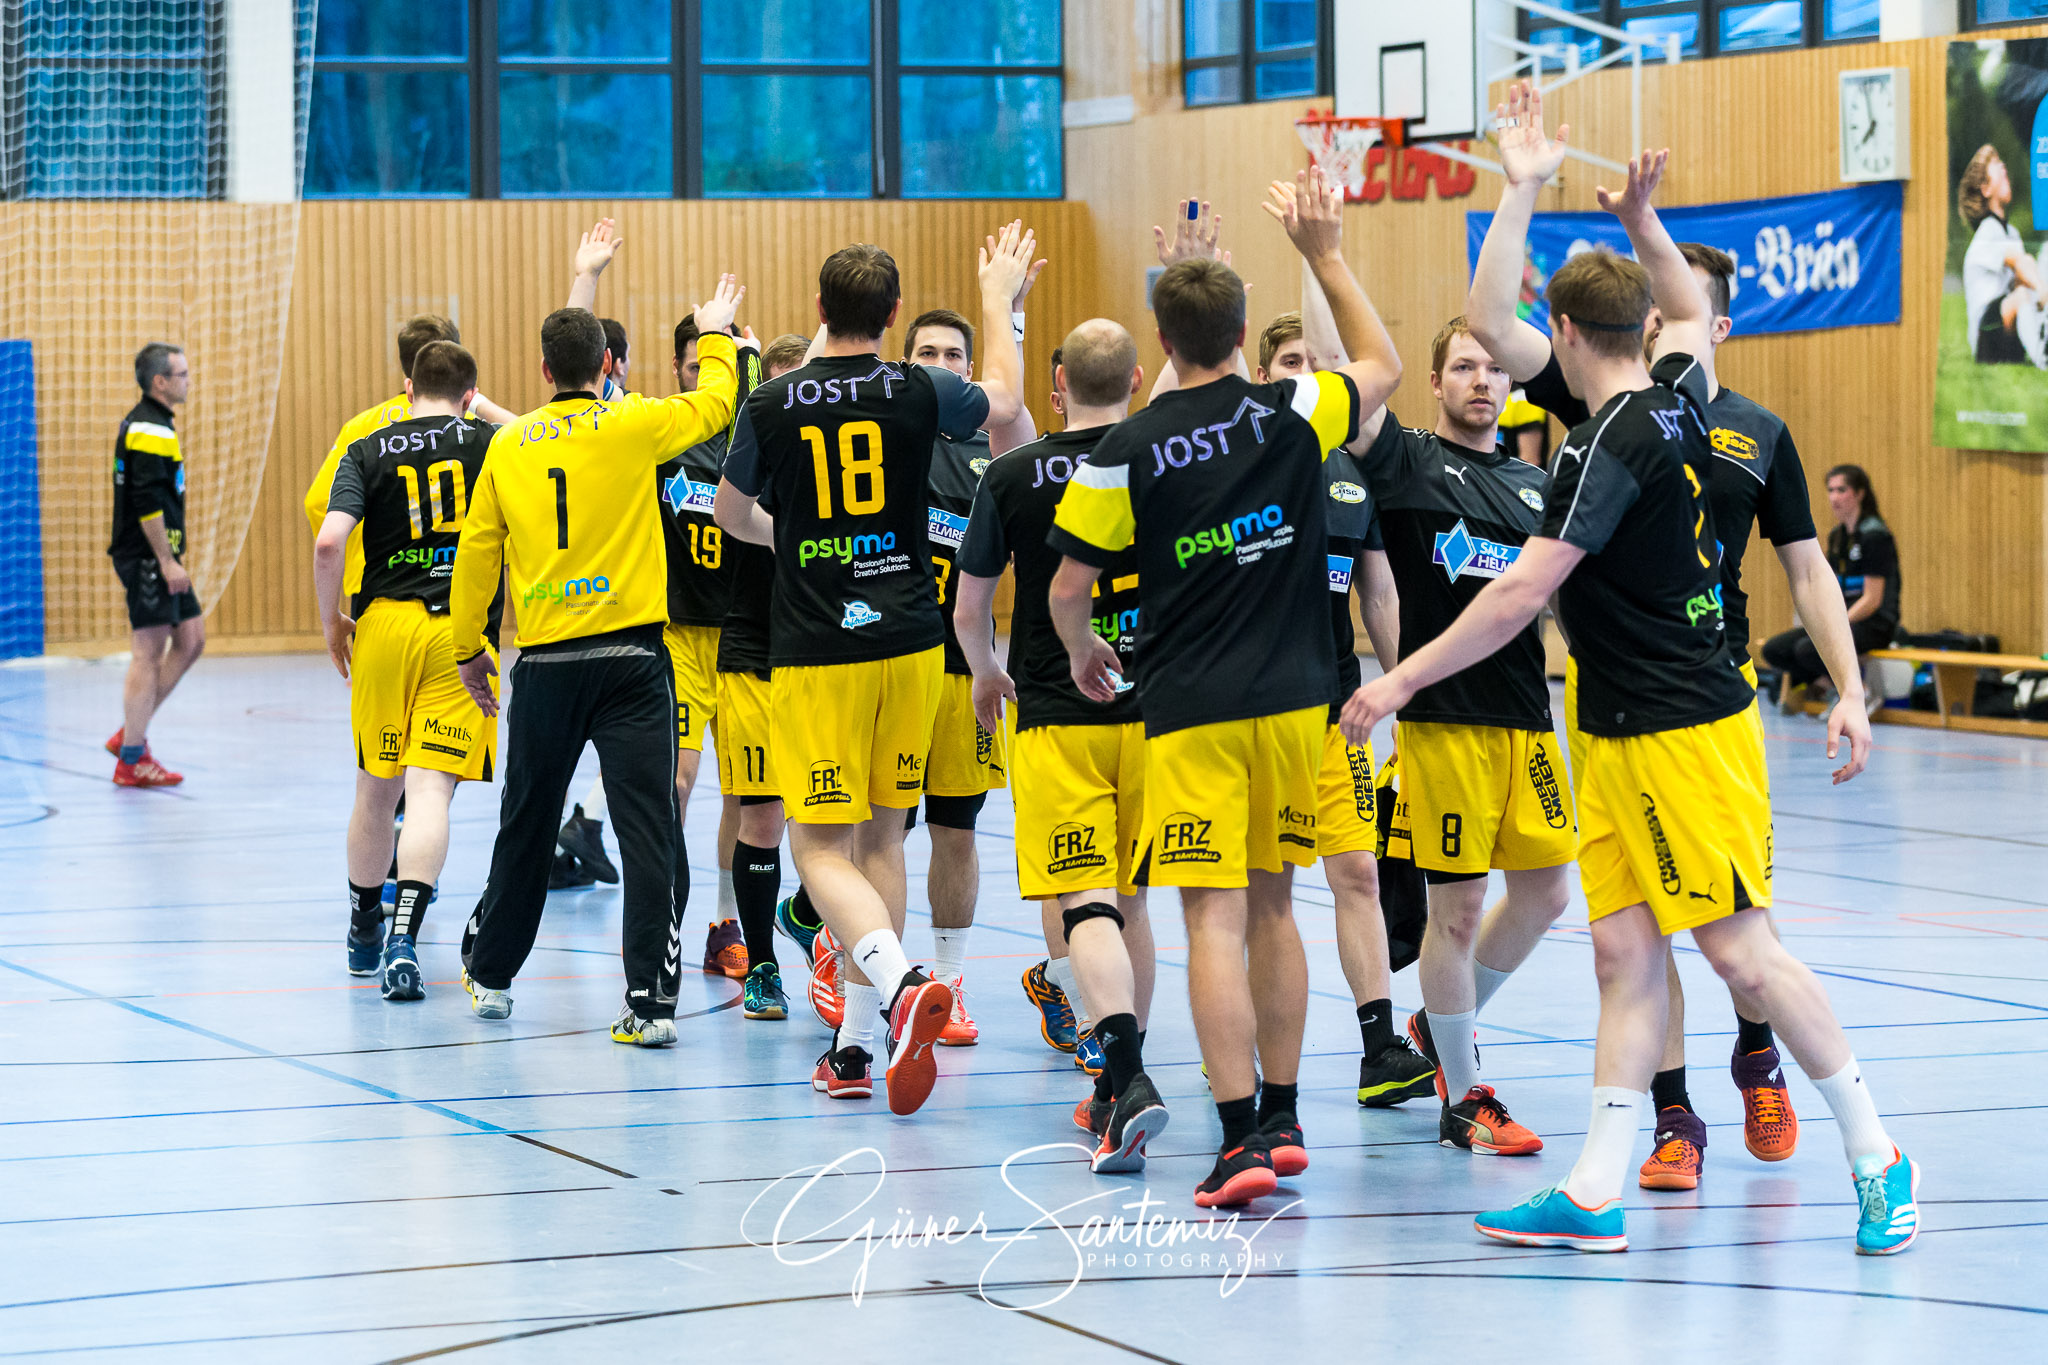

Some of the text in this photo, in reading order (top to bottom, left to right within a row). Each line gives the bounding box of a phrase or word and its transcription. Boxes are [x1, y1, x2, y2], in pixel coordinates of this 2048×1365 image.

[784, 377, 866, 409] JOST
[378, 406, 413, 424] JO
[520, 413, 577, 446] JOST
[379, 429, 443, 458] JOST
[1152, 421, 1233, 477] JOST
[800, 420, 886, 520] 18
[1032, 454, 1090, 488] JO
[397, 459, 467, 540] 10
[695, 484, 718, 497] SAL
[548, 468, 569, 550] 1
[928, 510, 950, 526] ALZ
[688, 523, 722, 570] 19
[928, 521, 964, 542] ELMRE
[388, 546, 457, 569] psym
[798, 531, 896, 568] psyma
[887, 554, 911, 563] People.
[1480, 541, 1508, 560] SALZ
[880, 564, 911, 574] Solutions.
[523, 575, 610, 609] psyma
[1089, 607, 1140, 643] sym
[424, 717, 472, 742] Mentis
[744, 746, 765, 782] 11
[1357, 749, 1375, 812] MEIER
[1348, 752, 1366, 811] ROBERT
[1535, 751, 1563, 818] MEIER
[1278, 805, 1316, 828] Men
[1054, 826, 1096, 859] FRZ
[1164, 820, 1212, 850] FRZ
[1442, 813, 1462, 858] 8
